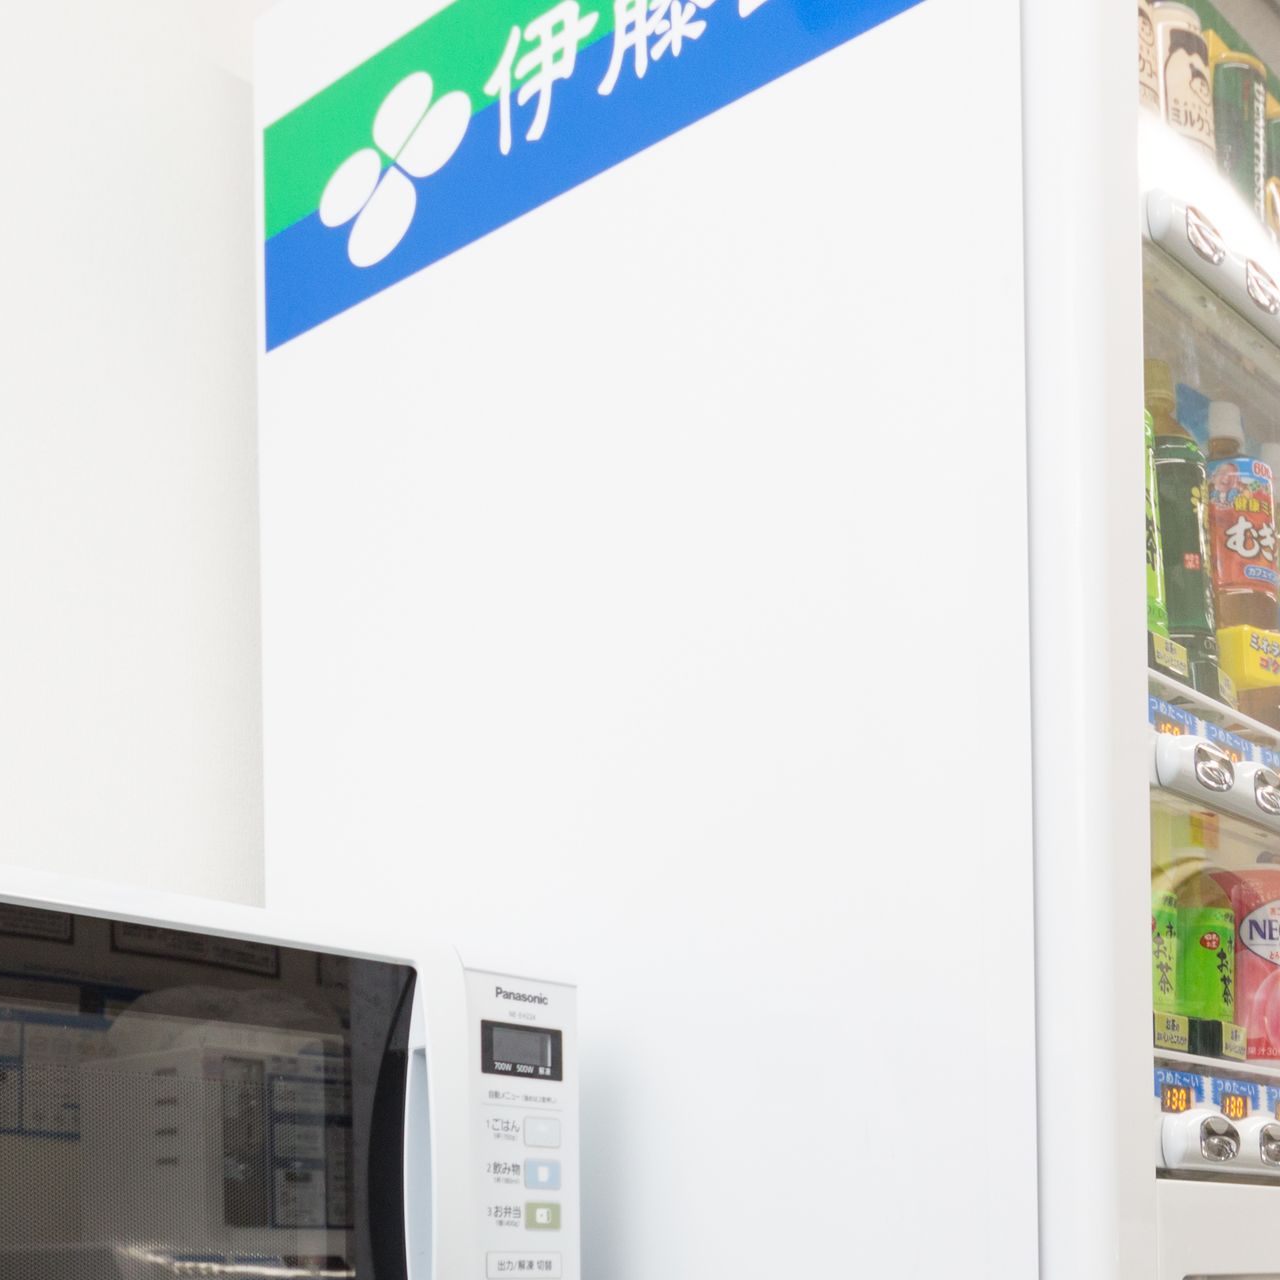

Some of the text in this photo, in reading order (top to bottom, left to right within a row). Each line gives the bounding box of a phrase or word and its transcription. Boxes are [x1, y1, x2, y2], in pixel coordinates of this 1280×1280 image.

[483, 0, 760, 156] 伊藤
[495, 986, 548, 1005] Panasonic
[1165, 1088, 1186, 1111] 130
[1224, 1095, 1243, 1118] 130
[491, 1118, 520, 1133] ごはん
[492, 1162, 521, 1176] 飲み物
[493, 1206, 521, 1219] お弁当
